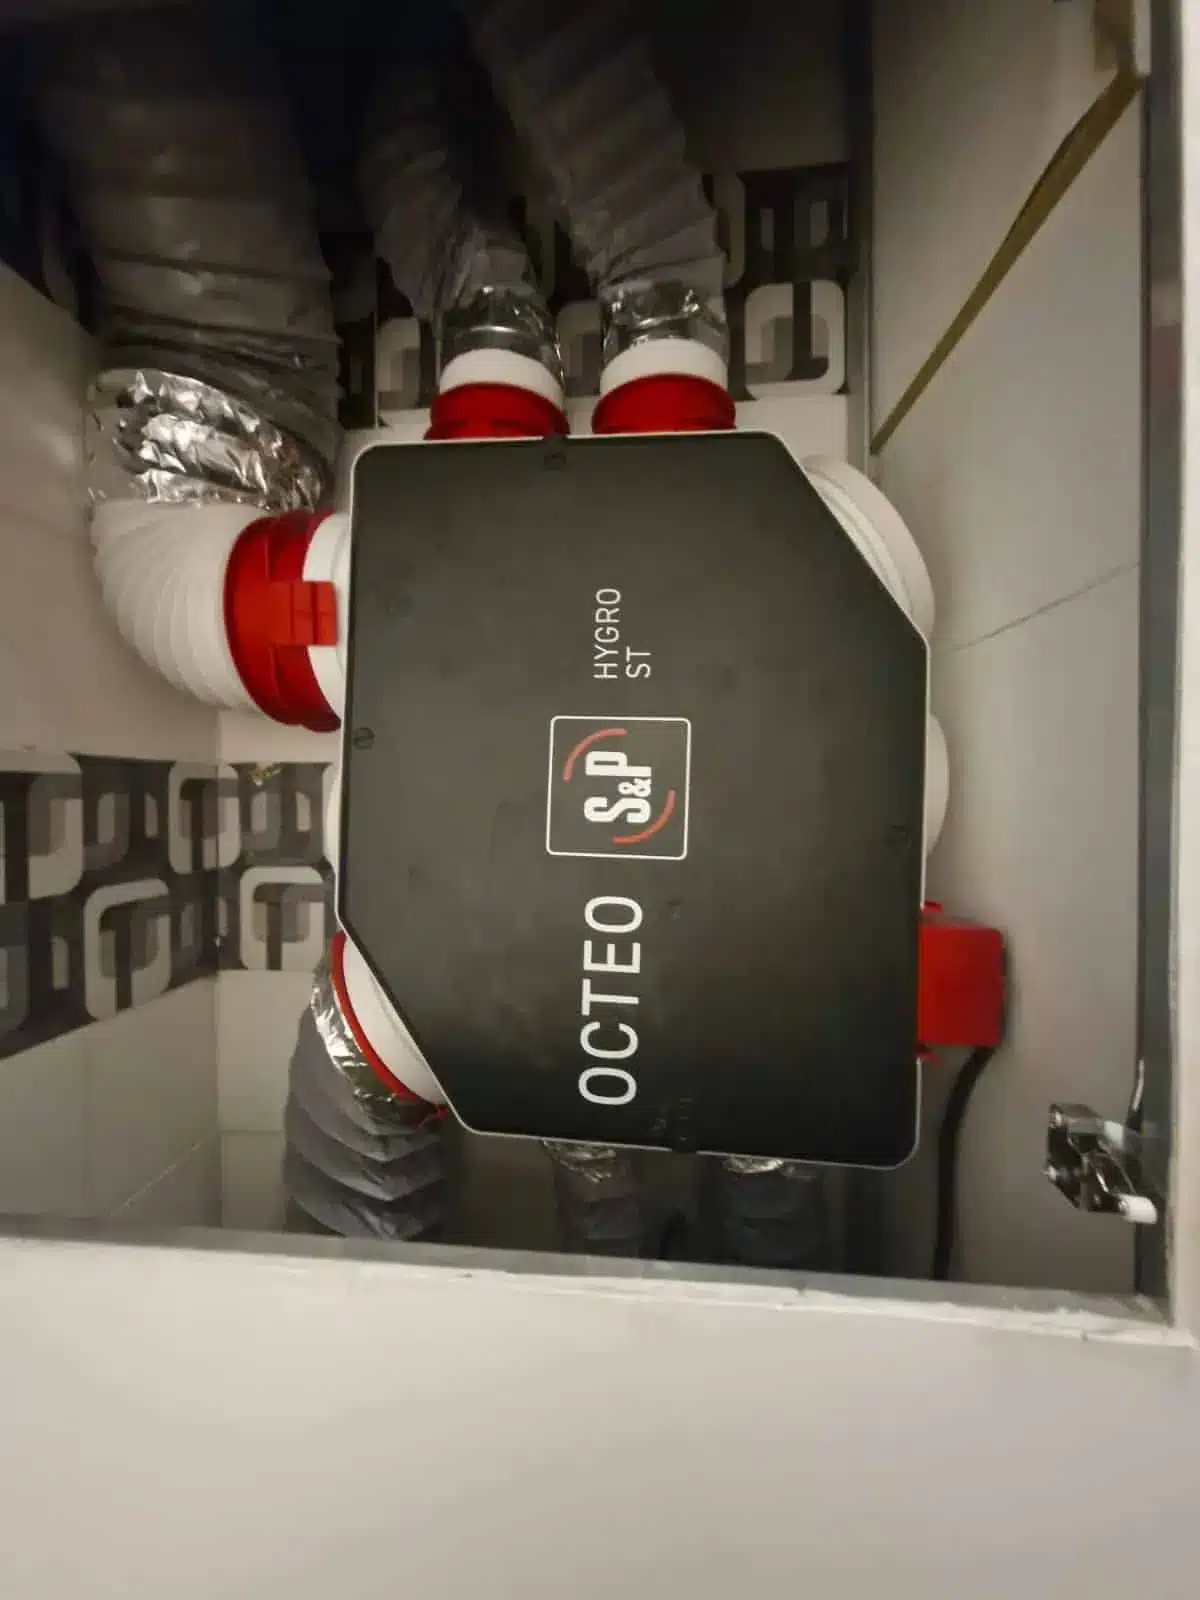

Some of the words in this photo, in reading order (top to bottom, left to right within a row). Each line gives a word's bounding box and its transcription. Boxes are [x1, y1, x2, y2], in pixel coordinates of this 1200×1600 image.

[593, 588, 621, 679] HYGRO
[625, 646, 652, 679] ST
[583, 750, 652, 824] S&P
[578, 895, 643, 1105] OCTEO
